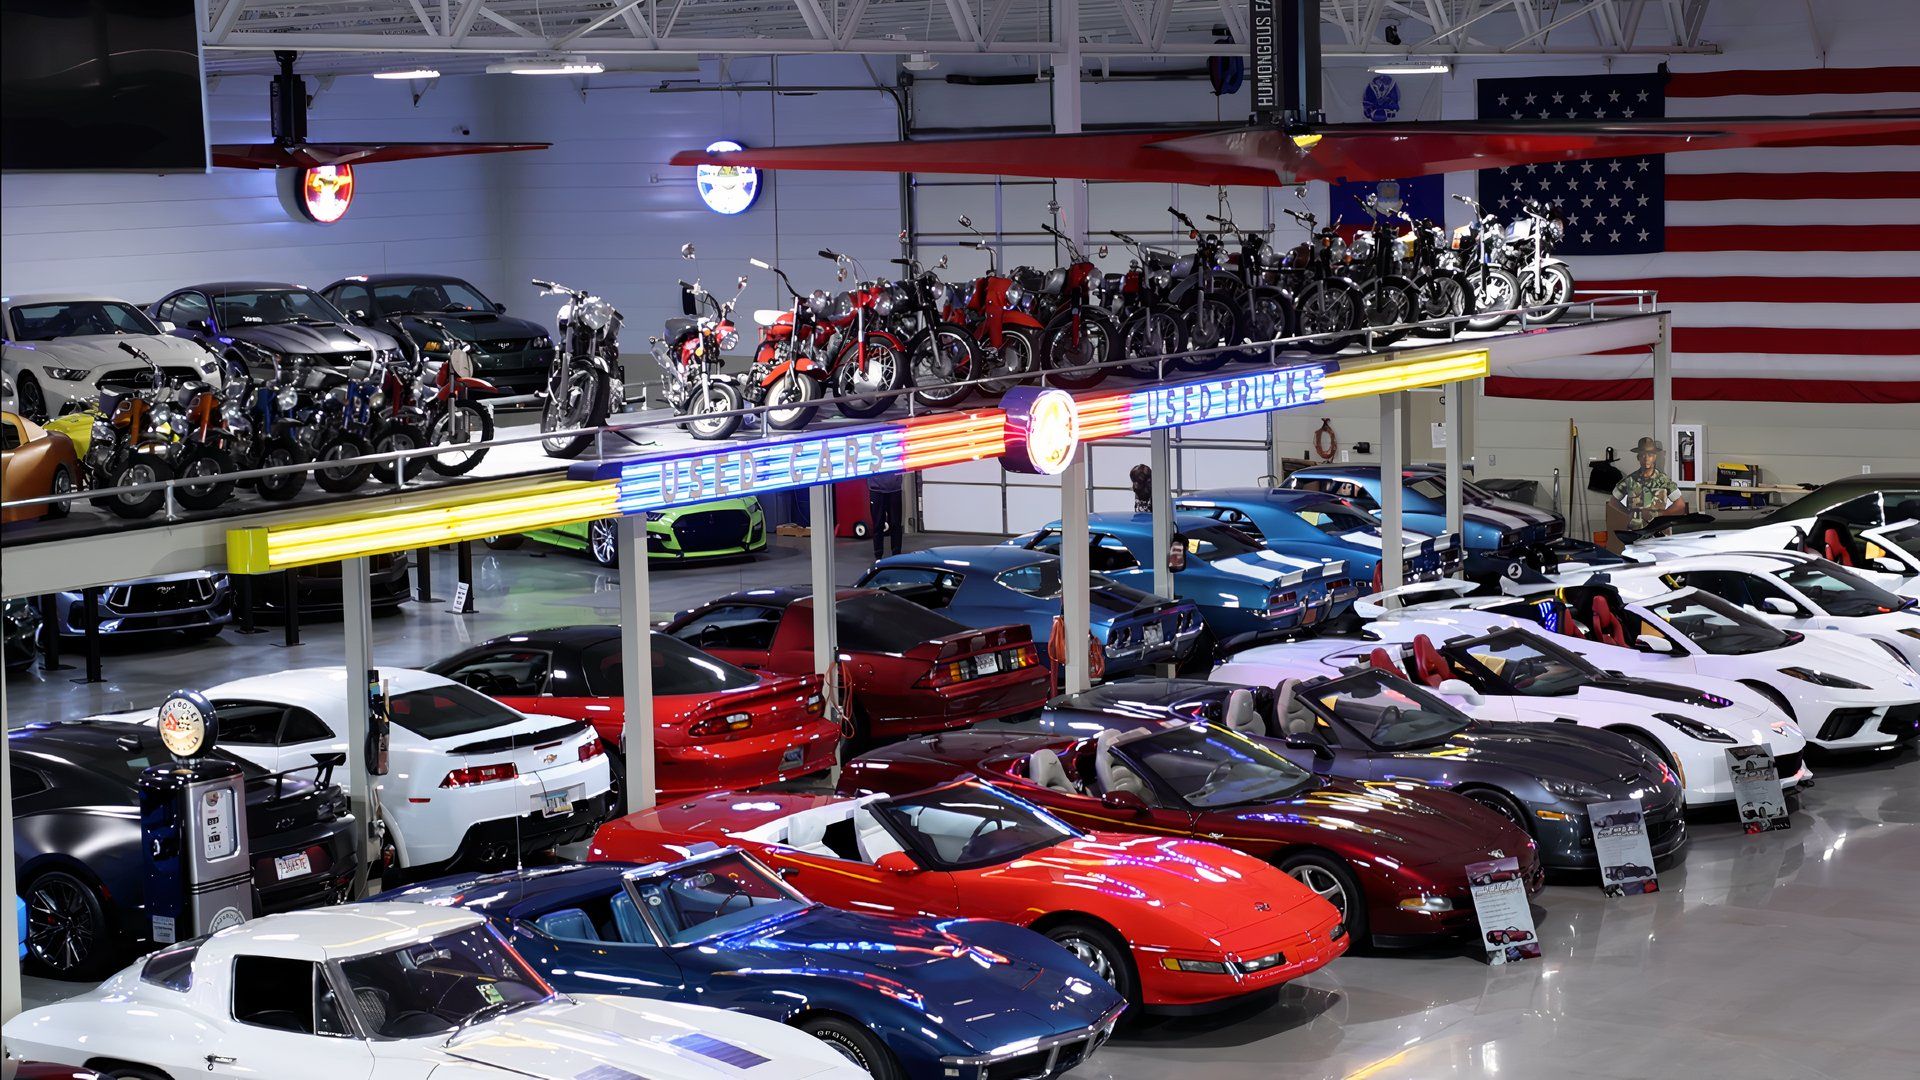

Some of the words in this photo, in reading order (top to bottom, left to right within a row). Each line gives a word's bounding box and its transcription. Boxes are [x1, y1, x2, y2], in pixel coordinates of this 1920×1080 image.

[1256, 17, 1273, 106] HUMONGOUS
[1147, 385, 1212, 426] USED
[1221, 370, 1313, 414] TRUCKS
[660, 450, 757, 504] USED
[789, 433, 884, 483] CARS
